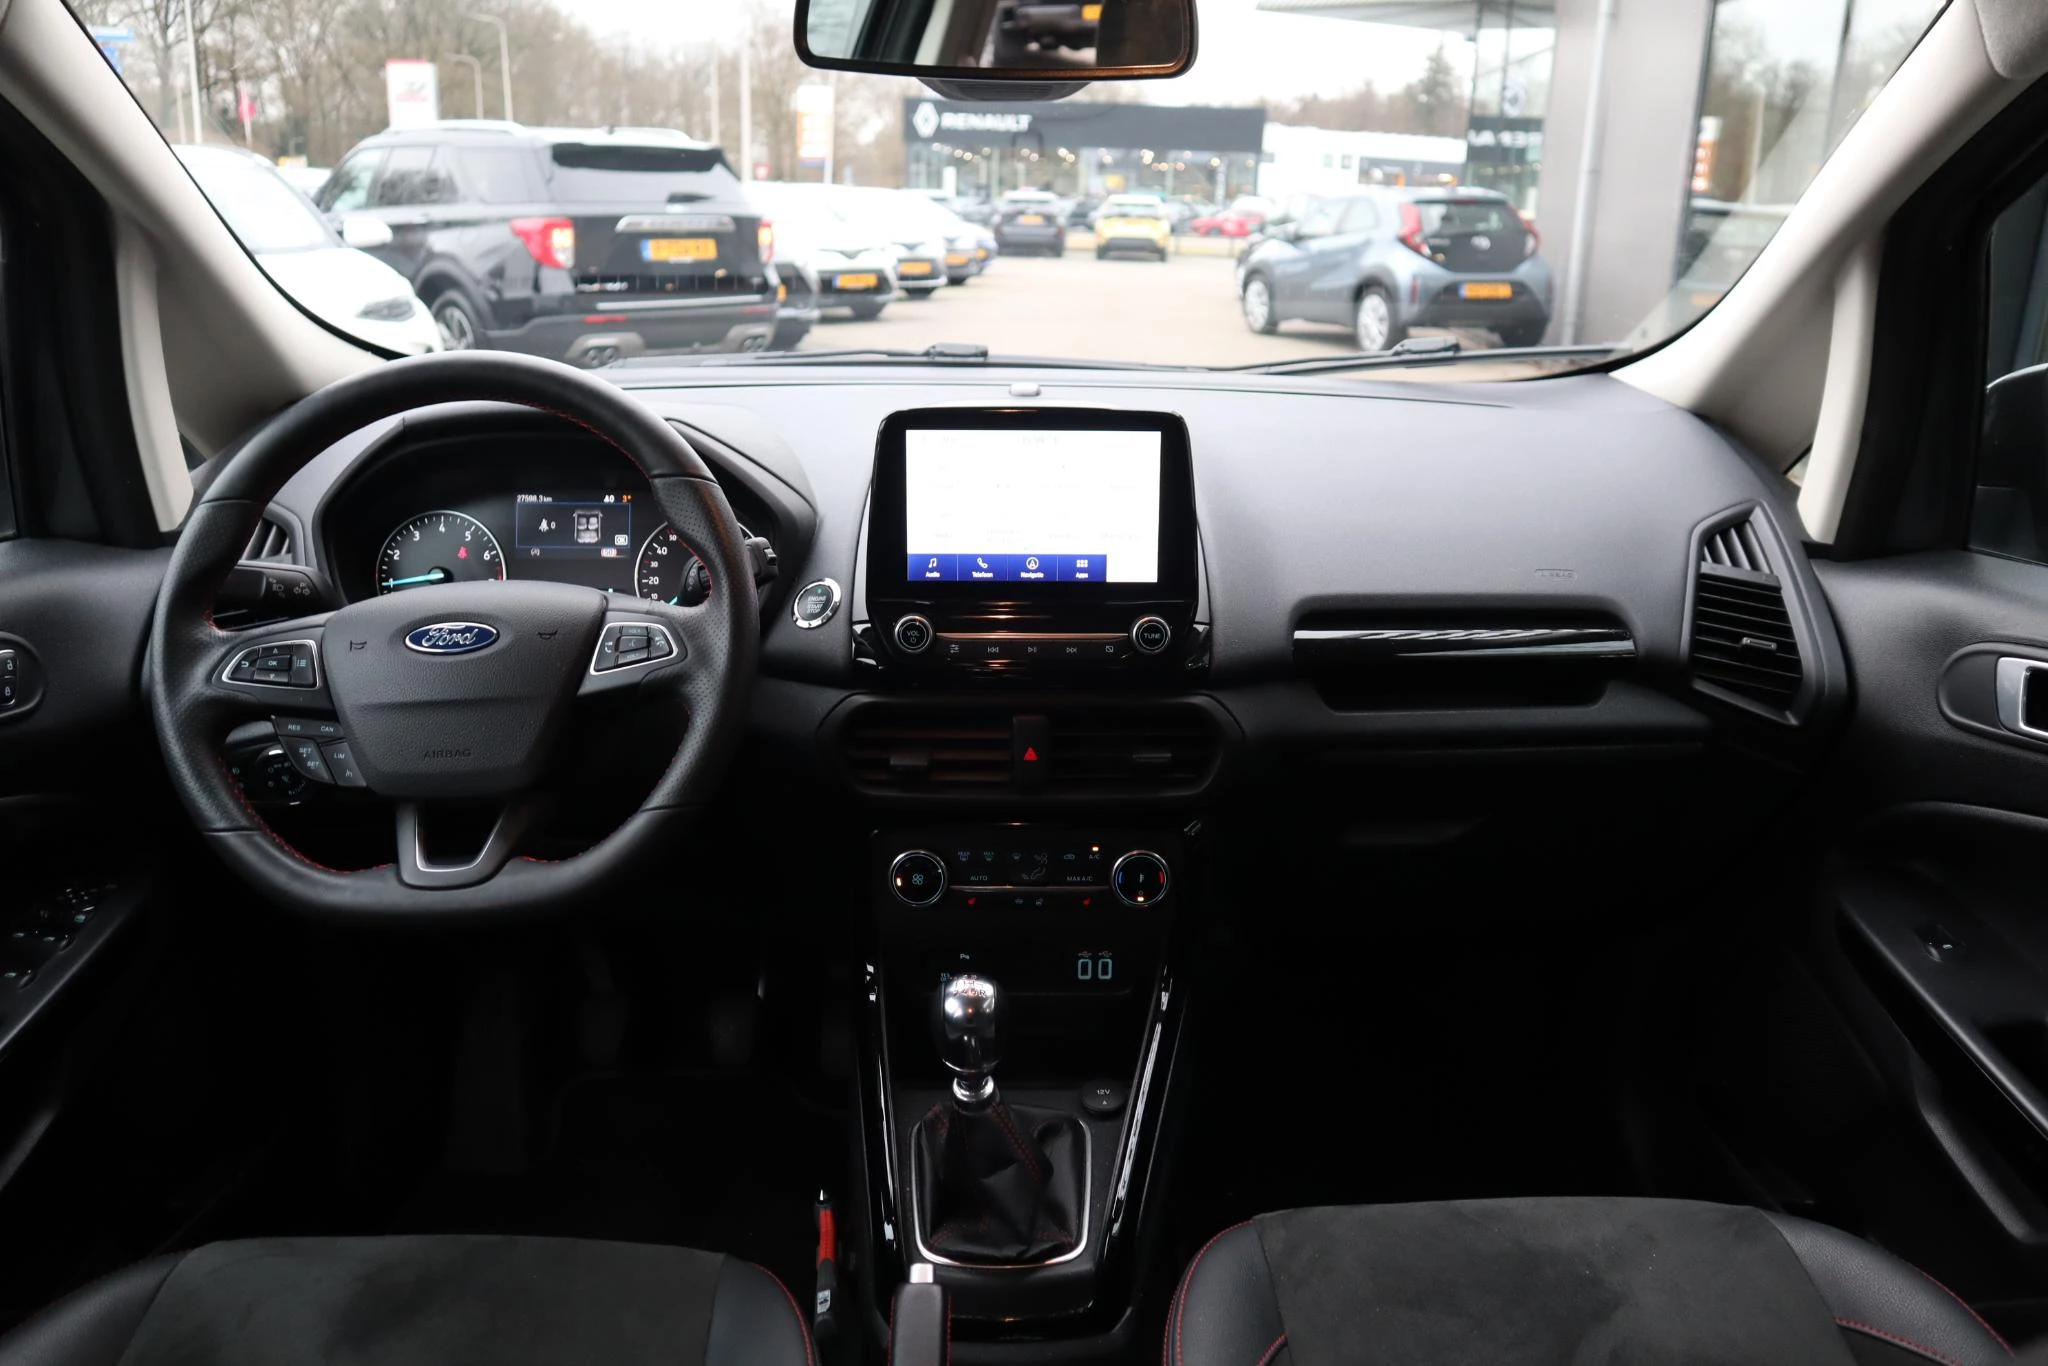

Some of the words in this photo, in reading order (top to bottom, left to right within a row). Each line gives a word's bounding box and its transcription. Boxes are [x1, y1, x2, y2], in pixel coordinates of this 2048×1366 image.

[941, 112, 1032, 132] RENAULT
[413, 531, 420, 541] 3
[465, 531, 471, 541] 5
[393, 550, 400, 560] 2
[483, 550, 490, 560] 6
[1075, 571, 1089, 579] Apps
[648, 576, 659, 585] 20
[421, 626, 480, 647] Ford
[423, 749, 472, 760] AIRBAG
